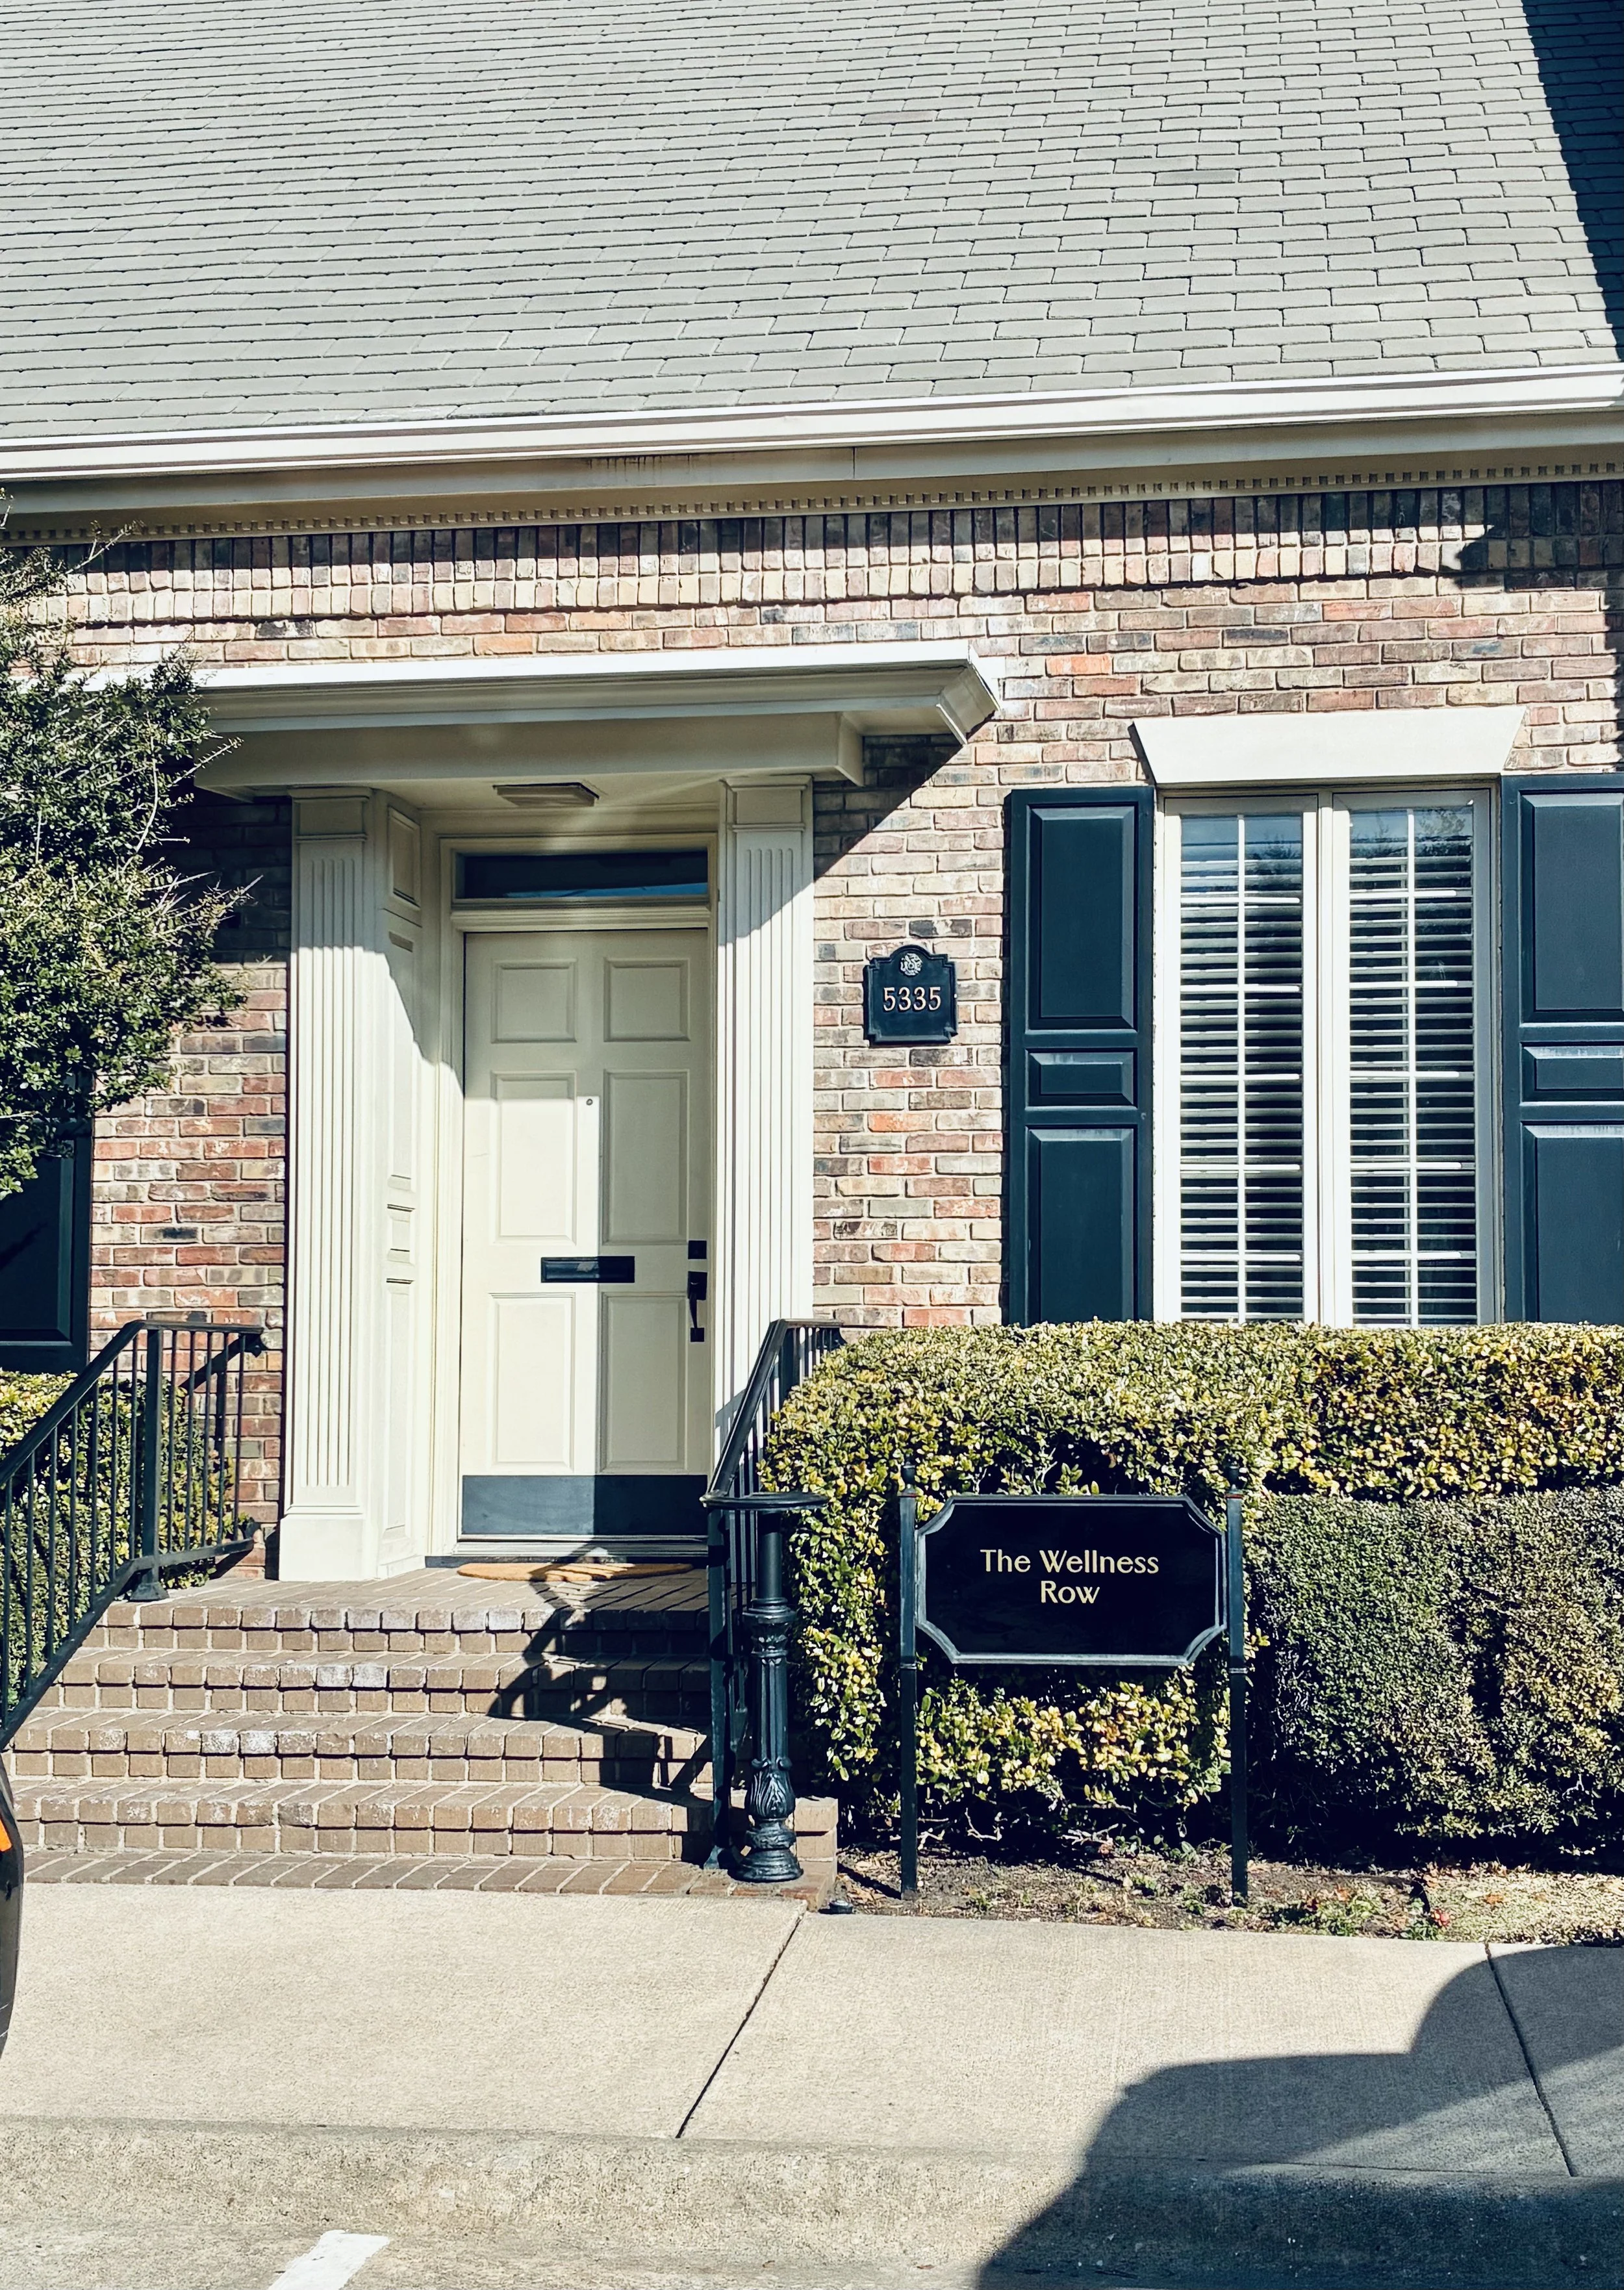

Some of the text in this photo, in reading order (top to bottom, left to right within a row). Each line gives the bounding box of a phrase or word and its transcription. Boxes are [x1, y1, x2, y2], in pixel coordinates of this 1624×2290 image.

[883, 986, 941, 1011] 5335
[980, 1549, 1160, 1574] The Wellness
[1041, 1581, 1100, 1604] Row
